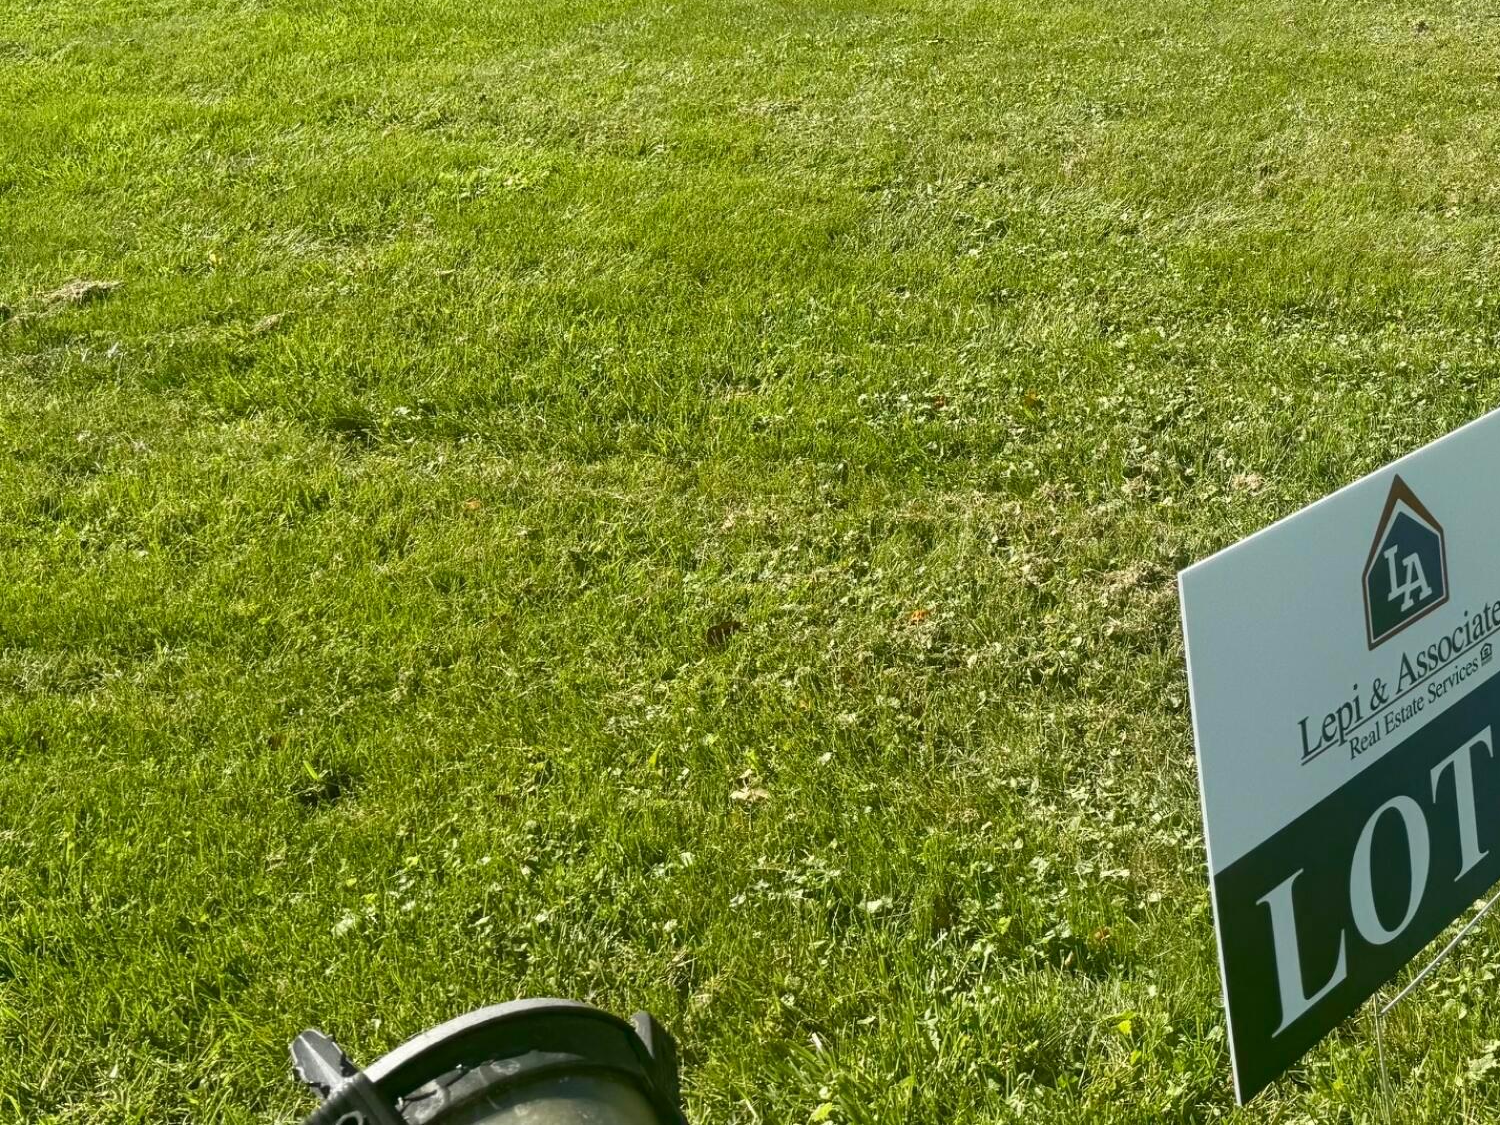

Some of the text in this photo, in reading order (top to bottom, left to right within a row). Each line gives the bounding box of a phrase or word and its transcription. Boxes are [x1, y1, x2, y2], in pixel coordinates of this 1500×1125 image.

[1383, 544, 1433, 612] LA
[1297, 683, 1364, 761] Lepi
[1370, 677, 1390, 711] &
[1349, 657, 1479, 761] Real Estate Services
[1256, 724, 1495, 1039] LOT
